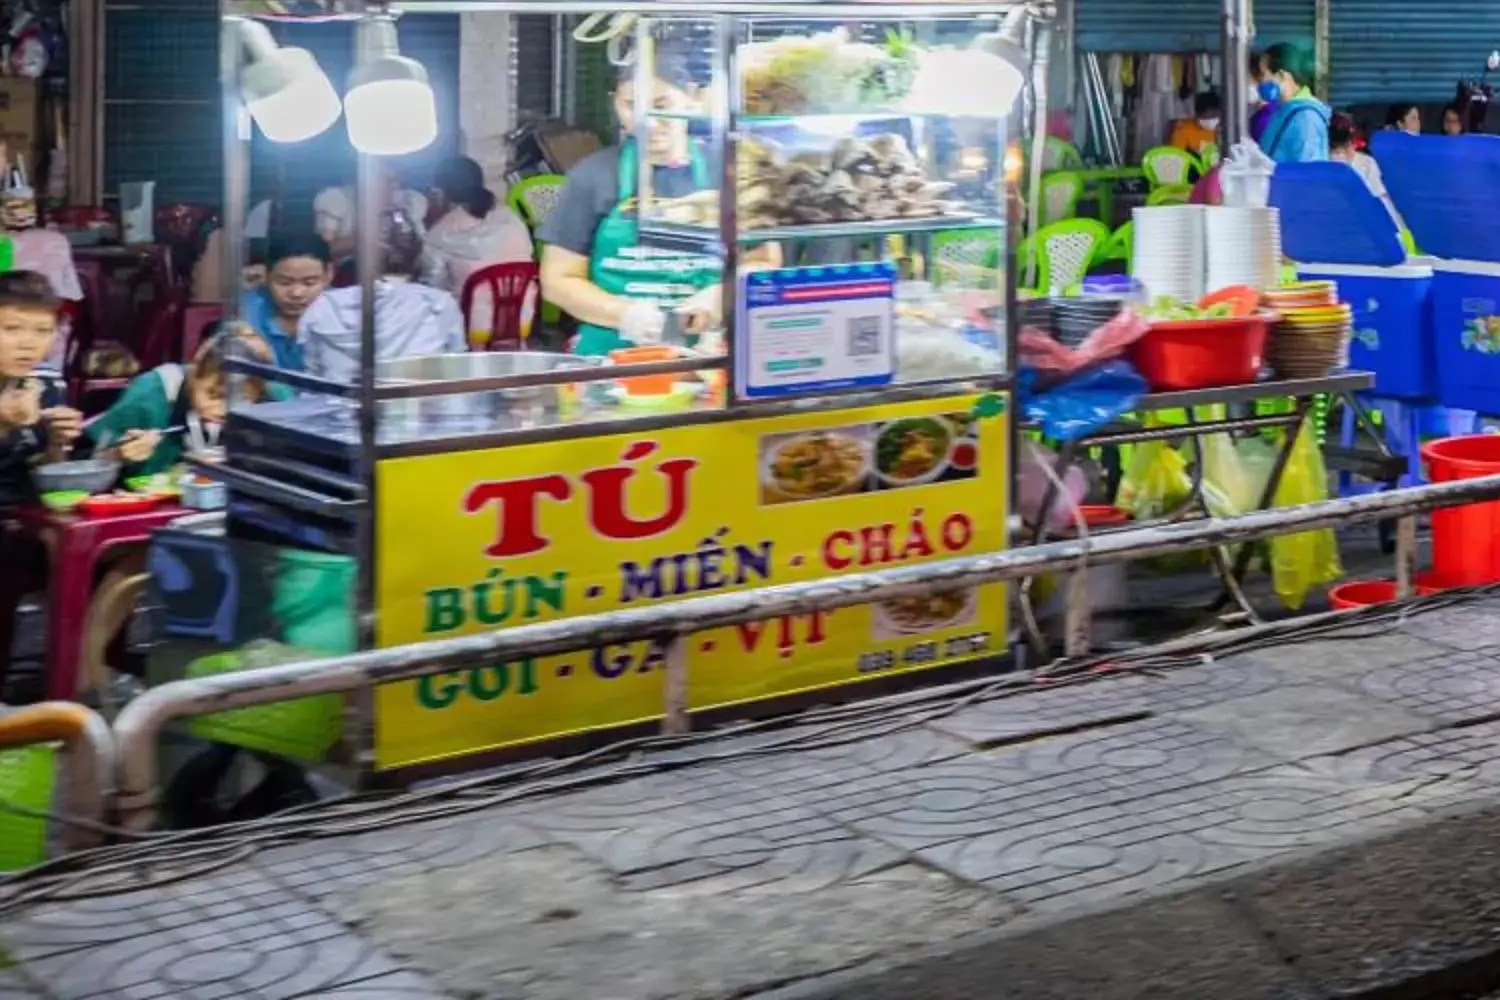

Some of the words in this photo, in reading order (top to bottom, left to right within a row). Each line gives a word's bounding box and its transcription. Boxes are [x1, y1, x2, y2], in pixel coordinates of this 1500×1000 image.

[461, 440, 698, 559] TÚ
[423, 568, 569, 634] BÚN
[620, 526, 777, 602] MIẾN
[822, 507, 974, 570] CHÁO
